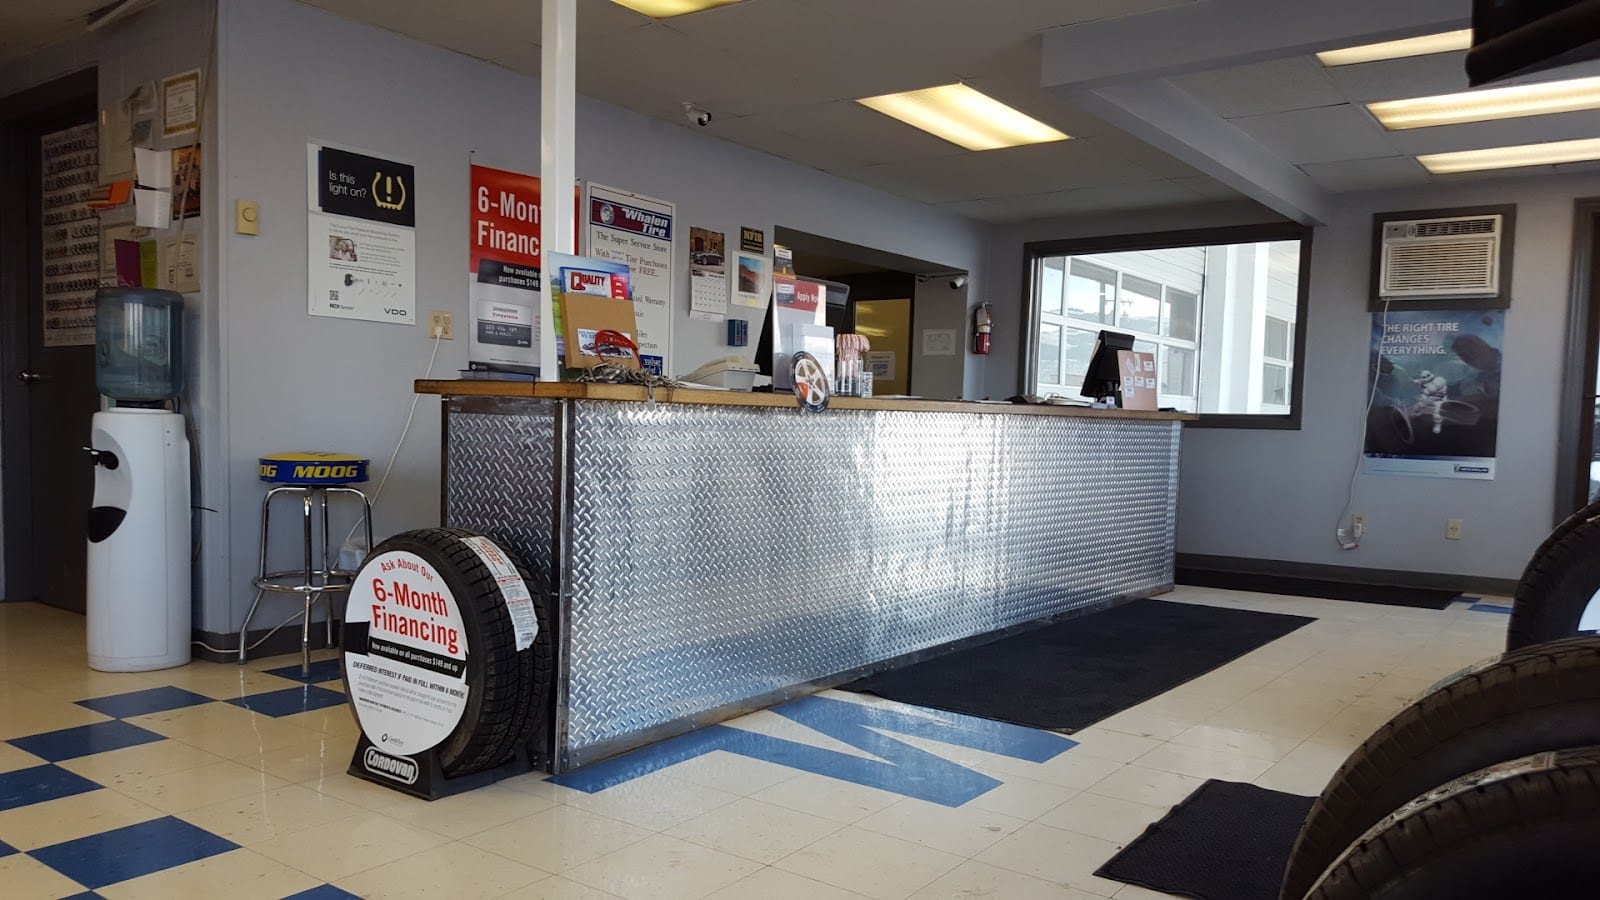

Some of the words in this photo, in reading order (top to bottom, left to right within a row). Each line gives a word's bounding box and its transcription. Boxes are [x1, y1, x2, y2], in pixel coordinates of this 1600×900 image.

[328, 169, 337, 181] Is
[339, 172, 356, 185] this
[328, 182, 348, 196] light
[350, 187, 367, 199] on?
[477, 185, 541, 225] 6-Mon
[621, 207, 669, 228] Whalen
[641, 222, 667, 237] Tire
[596, 230, 609, 241] The
[610, 233, 629, 246] Super
[630, 237, 651, 250] Service
[652, 242, 667, 253] Store
[595, 247, 610, 259] With
[625, 253, 639, 264] Tire
[639, 256, 668, 270] Purchases
[503, 265, 514, 274] Now
[515, 267, 538, 278] available
[498, 275, 526, 286] purchases
[570, 271, 606, 291] QUALITY
[797, 290, 811, 304] Apply
[811, 293, 819, 304] No
[383, 307, 407, 316] VDO
[1402, 323, 1432, 333] RIGHT
[1434, 322, 1460, 332] TIRE
[1382, 334, 1430, 344] CHANGES
[1380, 345, 1446, 355] EVERYTHING.
[293, 465, 359, 478] MOOG
[380, 560, 395, 573] Ask
[397, 558, 419, 573] About
[421, 566, 434, 583] Our
[372, 577, 449, 618] 6-Month
[371, 604, 460, 655] Financing
[371, 641, 380, 651] Now
[380, 645, 399, 656] available
[411, 653, 432, 666] purchases
[432, 657, 443, 668] $149
[443, 662, 452, 670] and
[452, 664, 459, 673] up
[352, 660, 378, 674] DEFERRED
[377, 668, 398, 680] INTEREST
[402, 674, 413, 683] PAID
[417, 680, 429, 690] FULL
[429, 682, 446, 694] WITHIN
